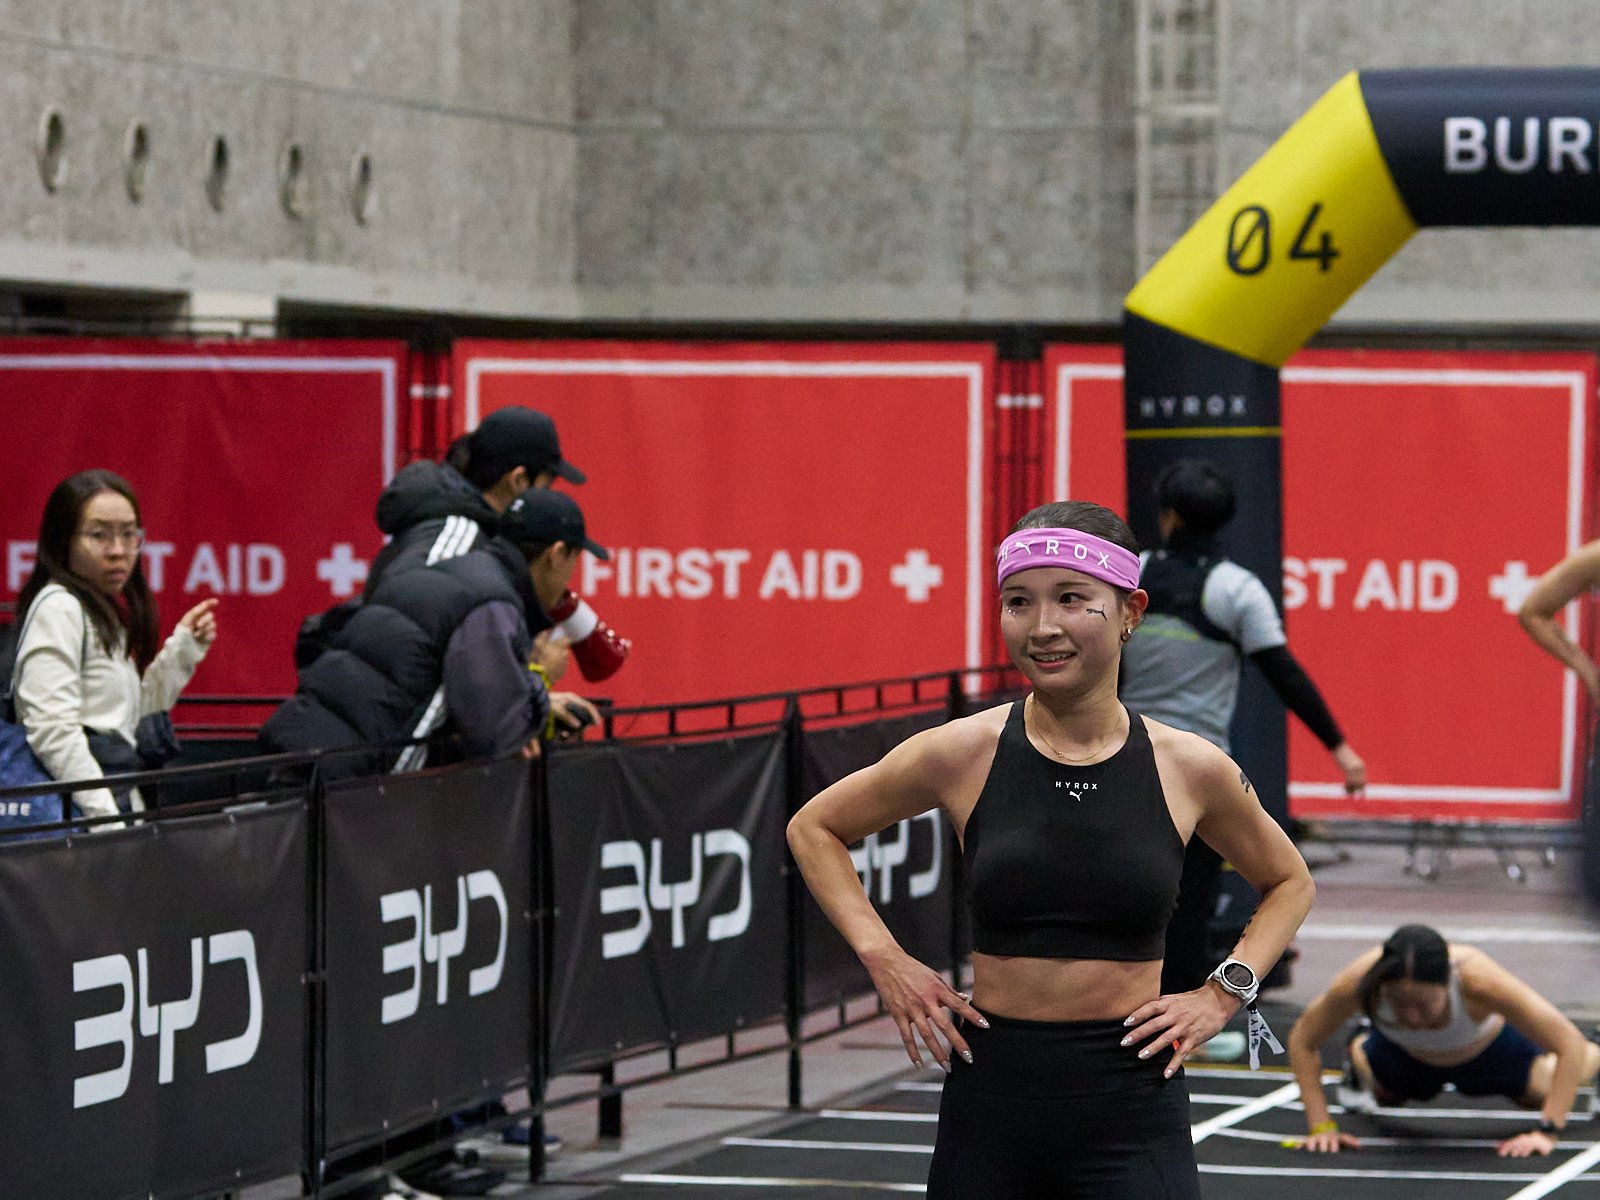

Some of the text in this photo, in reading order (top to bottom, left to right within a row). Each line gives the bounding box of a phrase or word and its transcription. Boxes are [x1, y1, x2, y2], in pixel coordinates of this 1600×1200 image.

[1444, 116, 1600, 174] BUR
[1227, 202, 1340, 276] 04
[1140, 394, 1248, 417] HYROX
[184, 543, 286, 595] AID
[581, 547, 862, 600] FIRST AID
[1353, 558, 1459, 612] AID
[1055, 781, 1098, 790] HYROX
[848, 808, 942, 904] YD
[600, 828, 752, 960] BYD
[380, 869, 508, 1025] BYD
[73, 929, 263, 1110] BYD
